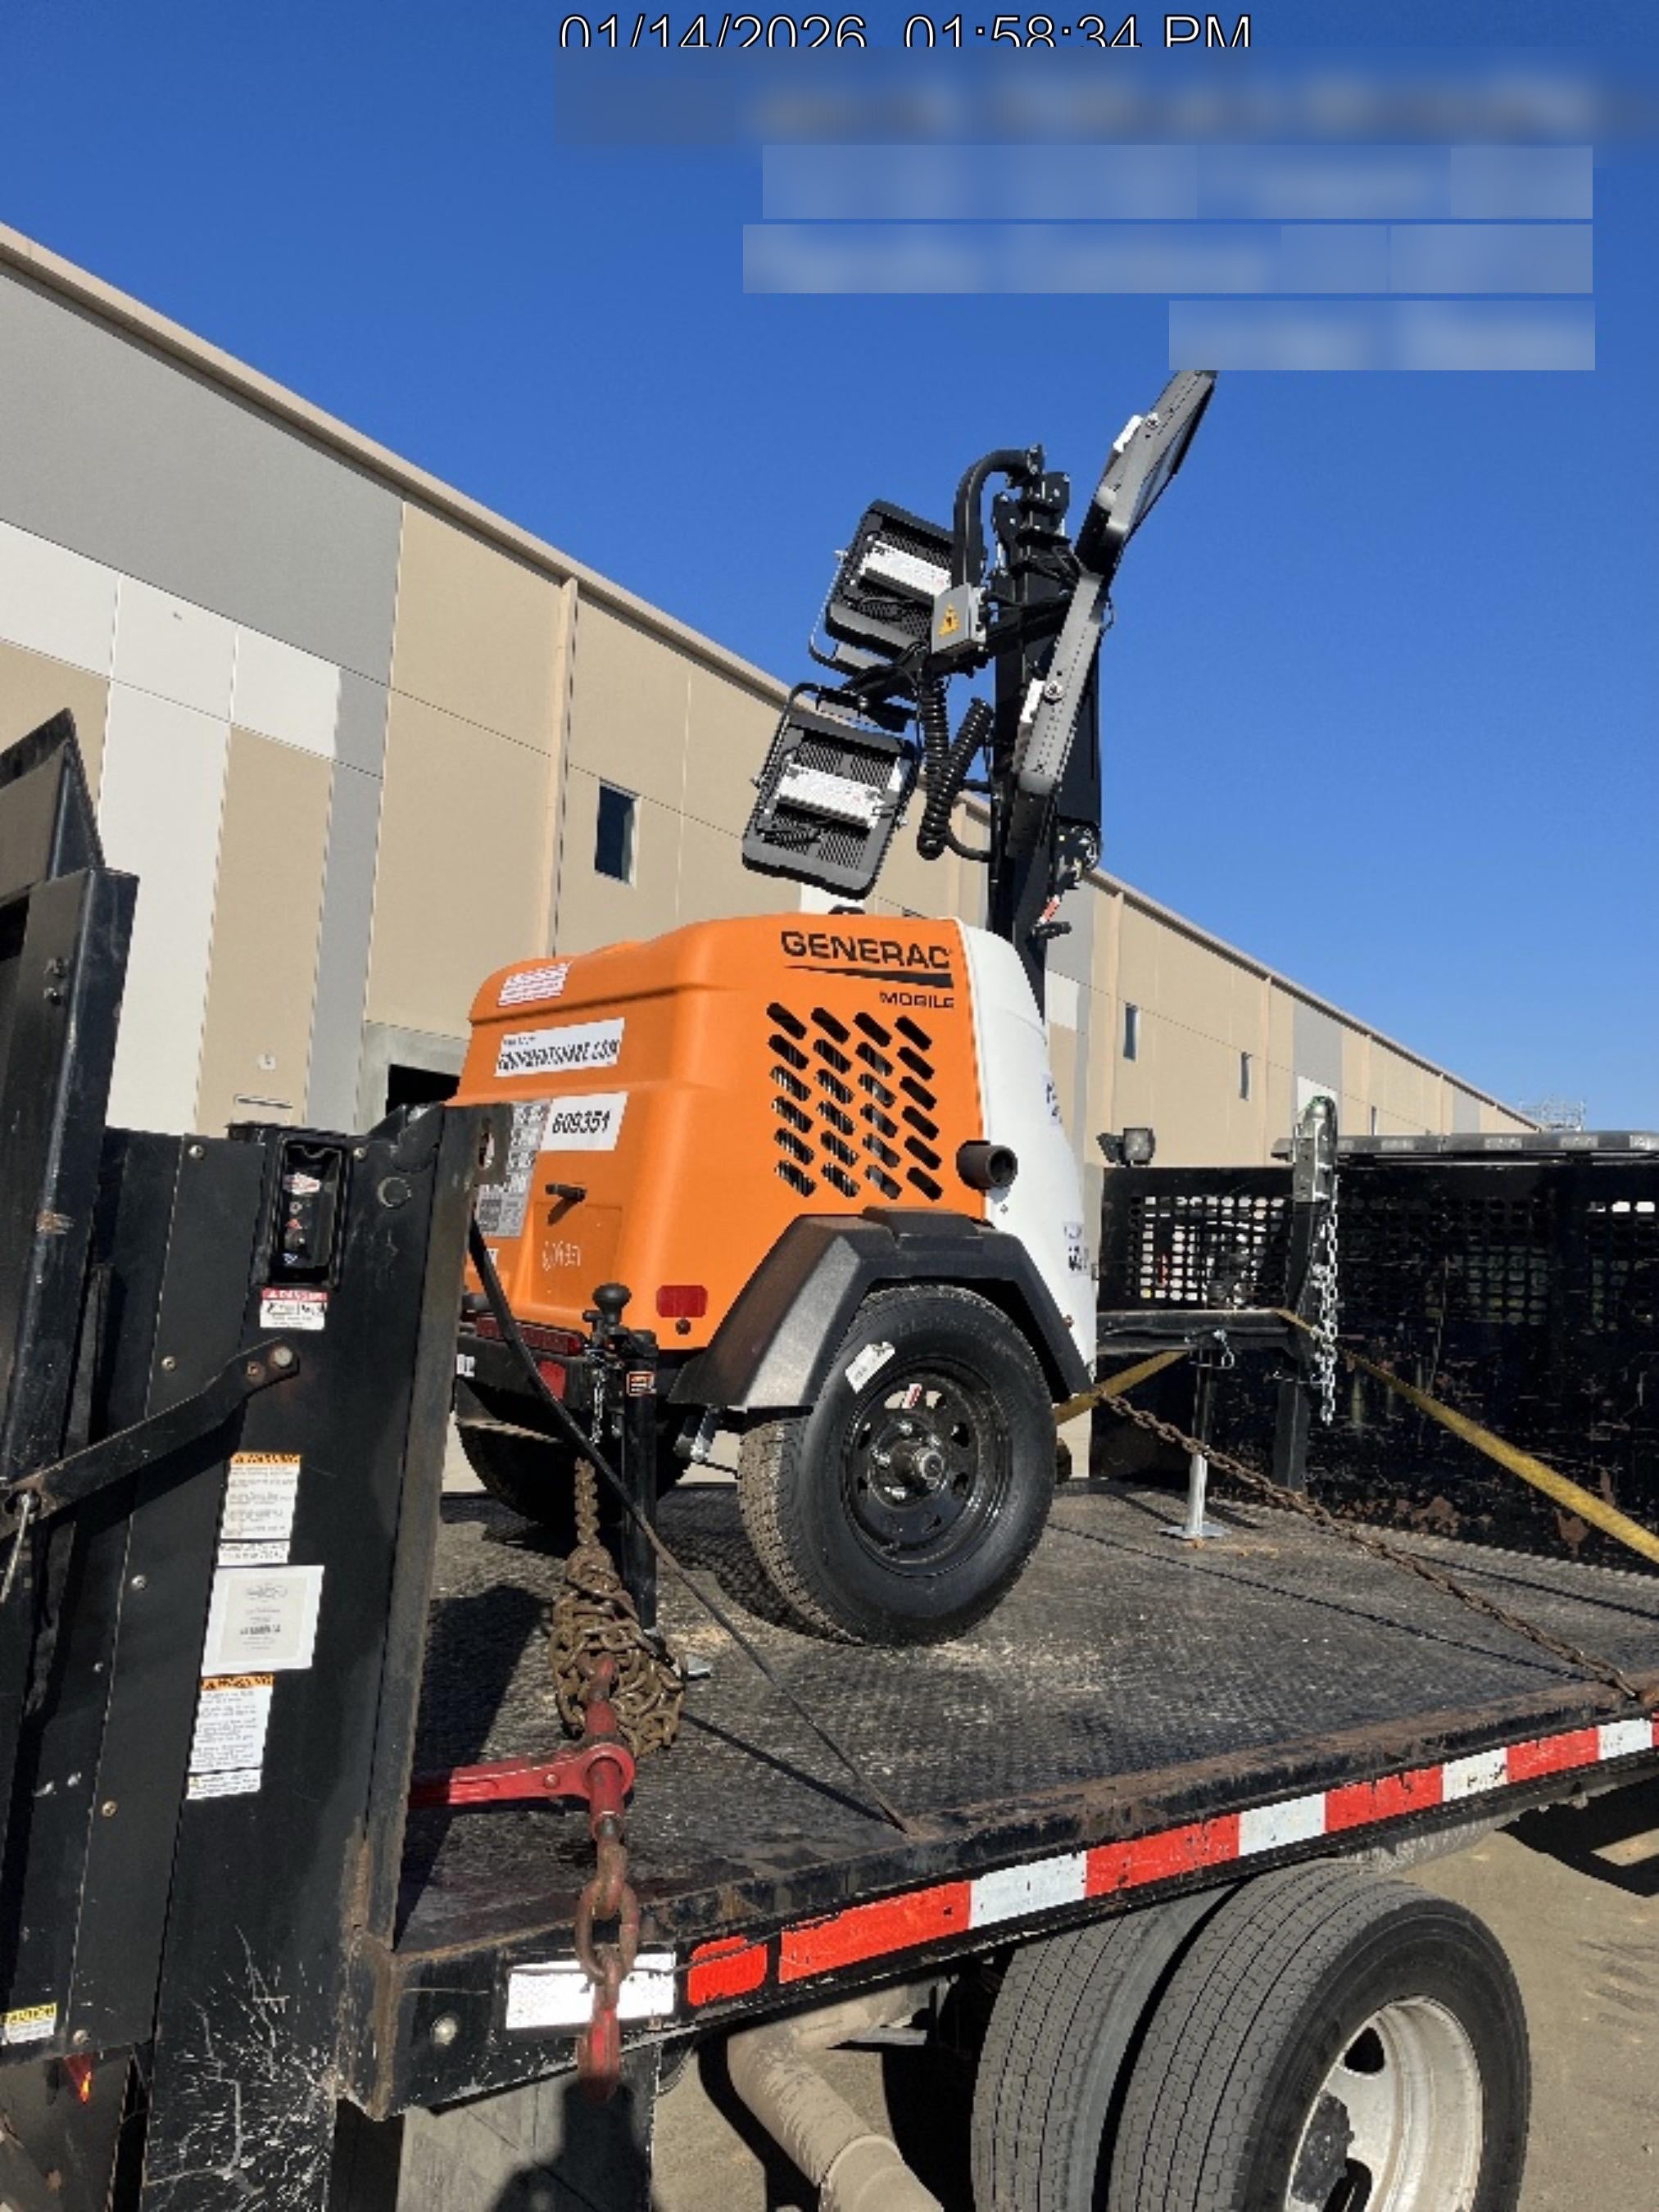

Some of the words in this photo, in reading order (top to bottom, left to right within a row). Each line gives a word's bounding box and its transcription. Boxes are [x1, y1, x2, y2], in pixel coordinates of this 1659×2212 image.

[781, 931, 950, 969] GENERAC
[880, 991, 954, 1009] MOBILE
[551, 1109, 611, 1135] 609351
